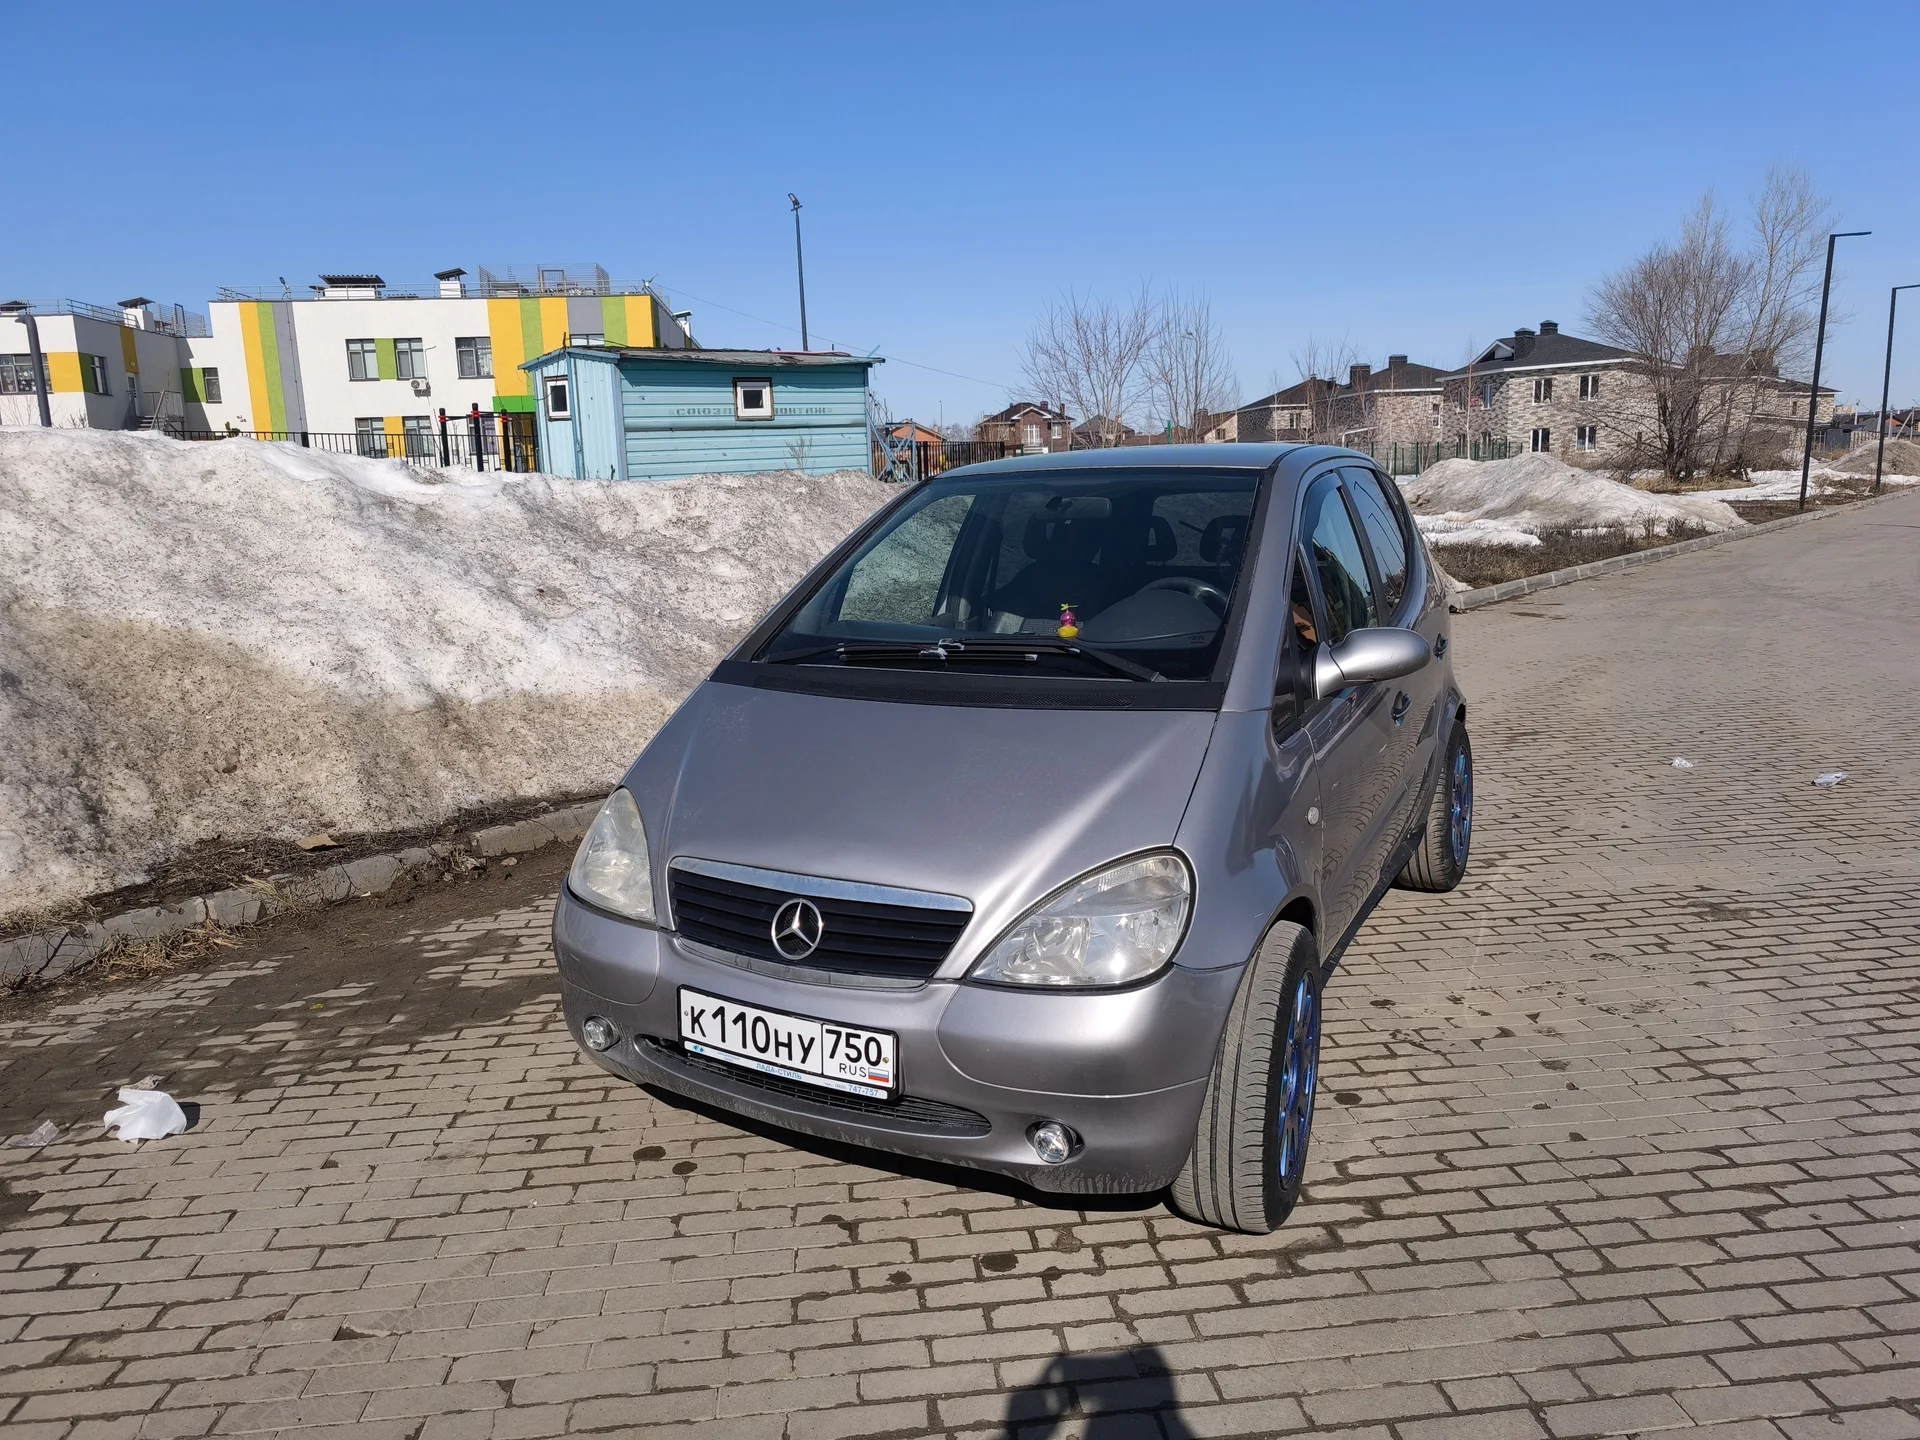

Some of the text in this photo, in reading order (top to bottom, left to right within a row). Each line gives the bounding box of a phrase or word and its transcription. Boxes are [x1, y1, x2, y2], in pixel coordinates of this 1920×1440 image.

[825, 1028, 882, 1066] 750
[756, 1063, 802, 1080] ЛАДА-СТИЛЬ
[839, 1062, 867, 1078] RUS
[848, 1084, 879, 1097] 747-757
